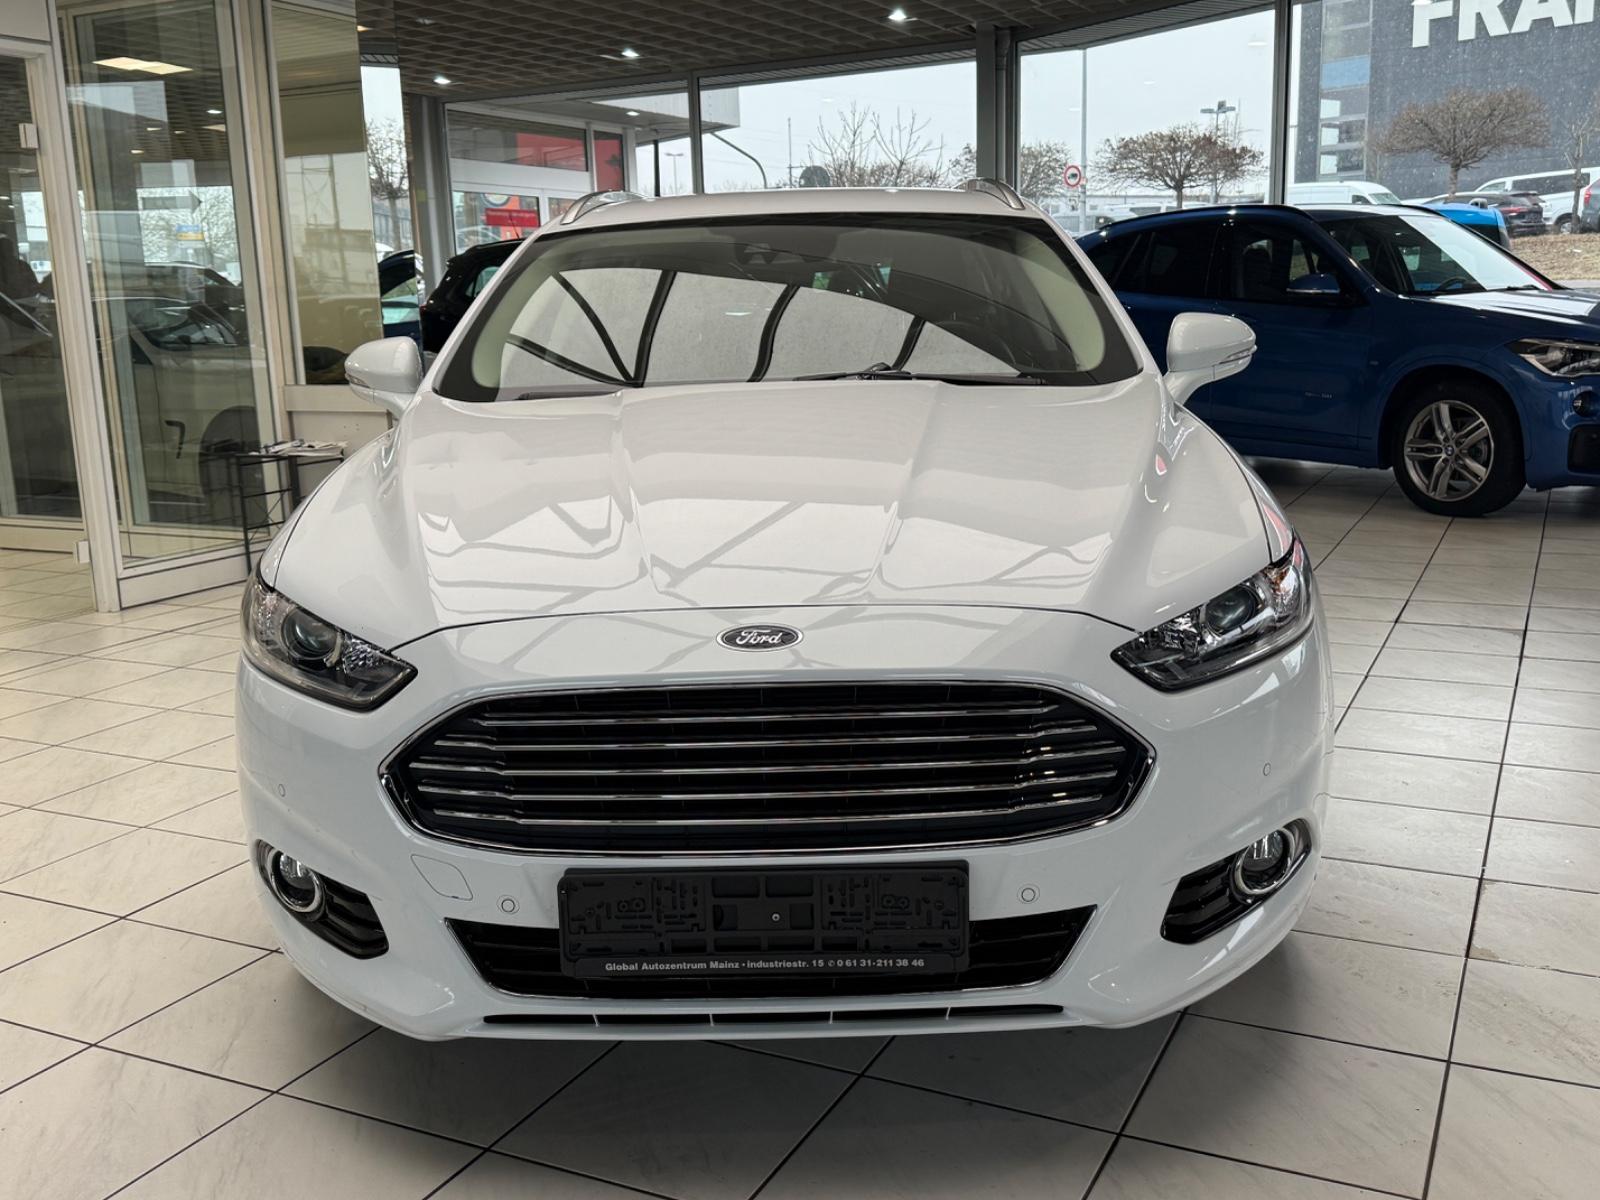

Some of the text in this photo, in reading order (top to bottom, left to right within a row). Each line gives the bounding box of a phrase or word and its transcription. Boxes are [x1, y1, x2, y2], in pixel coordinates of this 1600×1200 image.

[736, 629, 782, 644] Ford
[605, 962, 638, 971] Global
[641, 962, 707, 970] Autozentrum
[709, 960, 740, 969] Mainz
[812, 959, 824, 967] 15
[911, 959, 925, 967] 46
